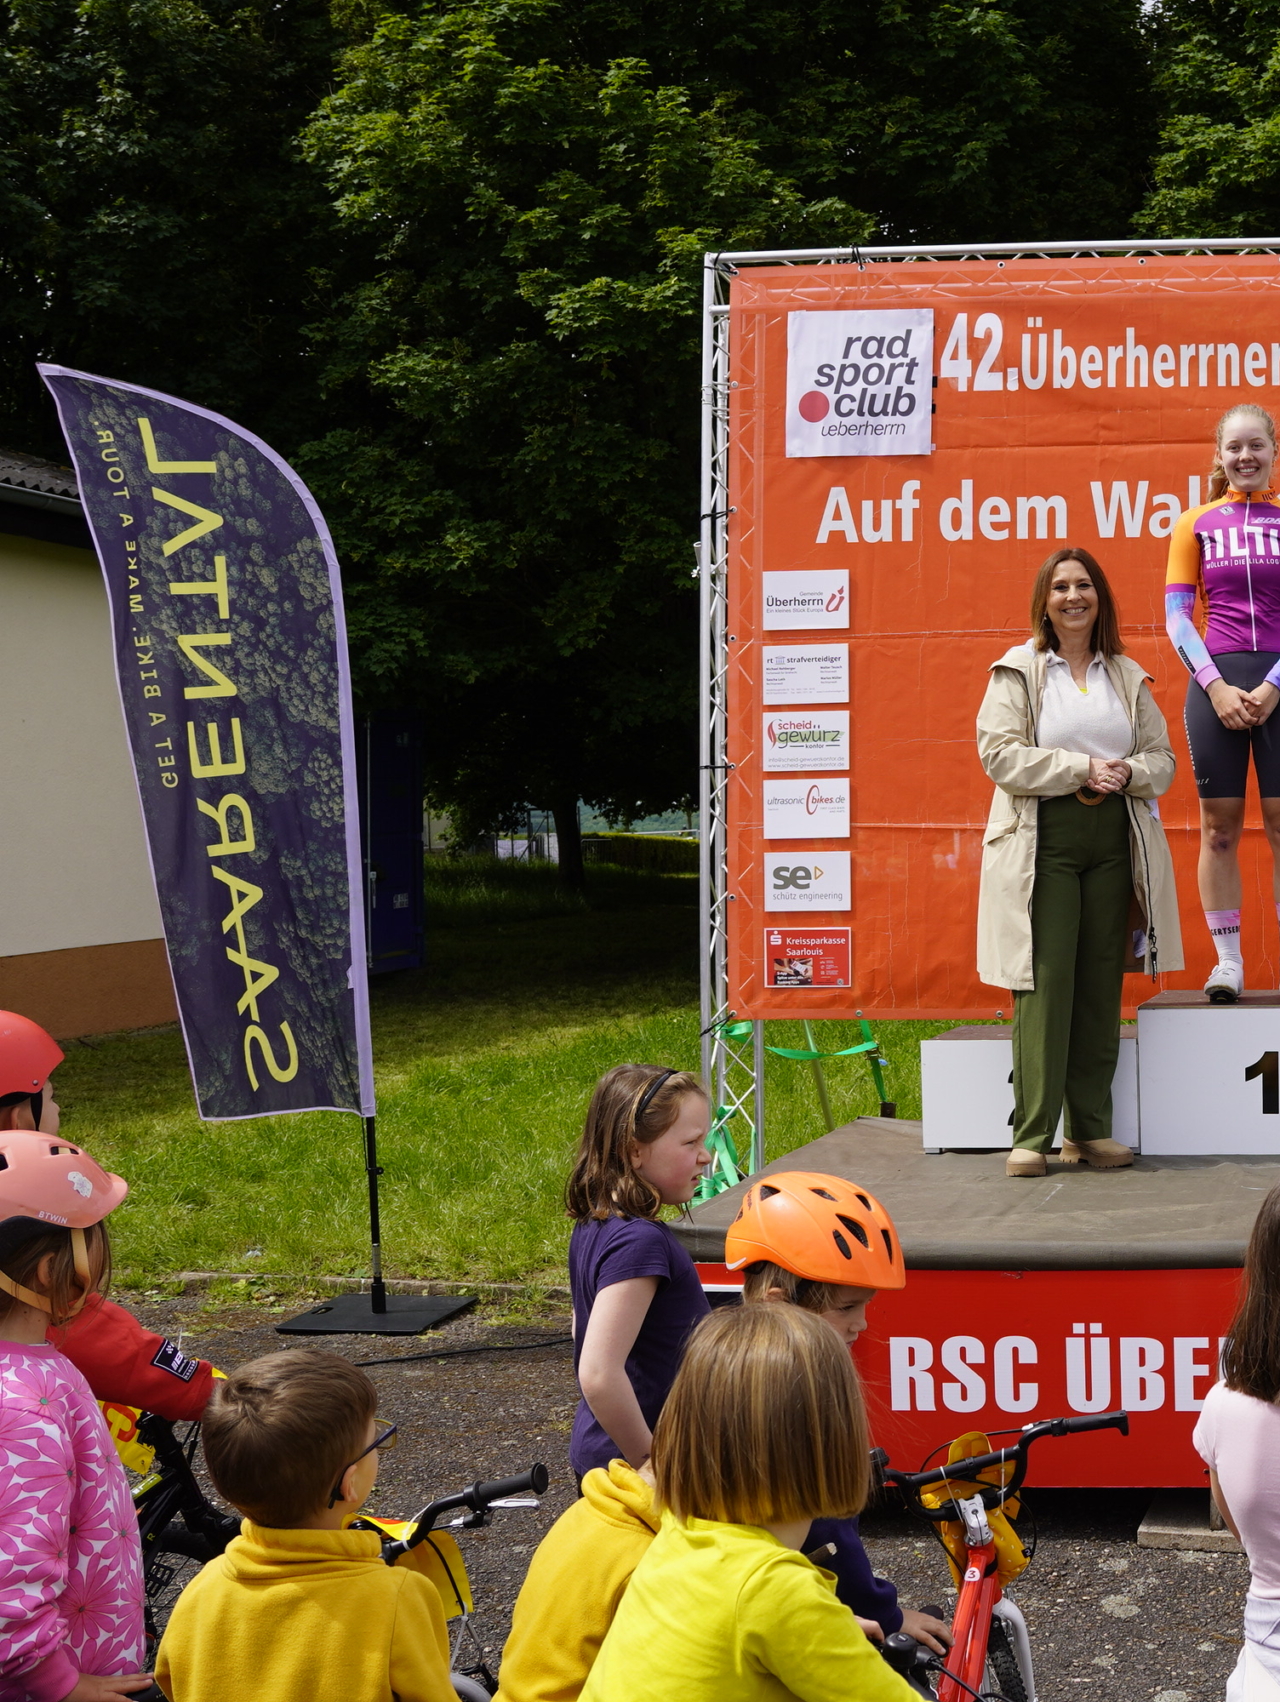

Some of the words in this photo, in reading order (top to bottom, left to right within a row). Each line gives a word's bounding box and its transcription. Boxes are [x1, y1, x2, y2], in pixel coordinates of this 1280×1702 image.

[842, 329, 912, 359] rad
[814, 357, 919, 394] sport
[834, 386, 916, 418] club
[822, 421, 906, 436] ueberherrn
[816, 479, 920, 544] Auf
[940, 479, 1068, 541] dem
[1206, 560, 1228, 569] MÜLLER
[766, 596, 823, 606] Überherrn
[778, 721, 812, 730] scheid
[778, 725, 840, 749] gewürz
[772, 866, 812, 890] se
[773, 892, 796, 900] schütz
[799, 892, 843, 901] engineering
[786, 937, 846, 946] Kreissparkasse
[786, 948, 823, 956] Saarlouis
[1244, 1051, 1279, 1115] 1
[38, 1210, 68, 1224] BTWIN
[889, 1336, 1038, 1412] RSC
[968, 1570, 976, 1578] 3
